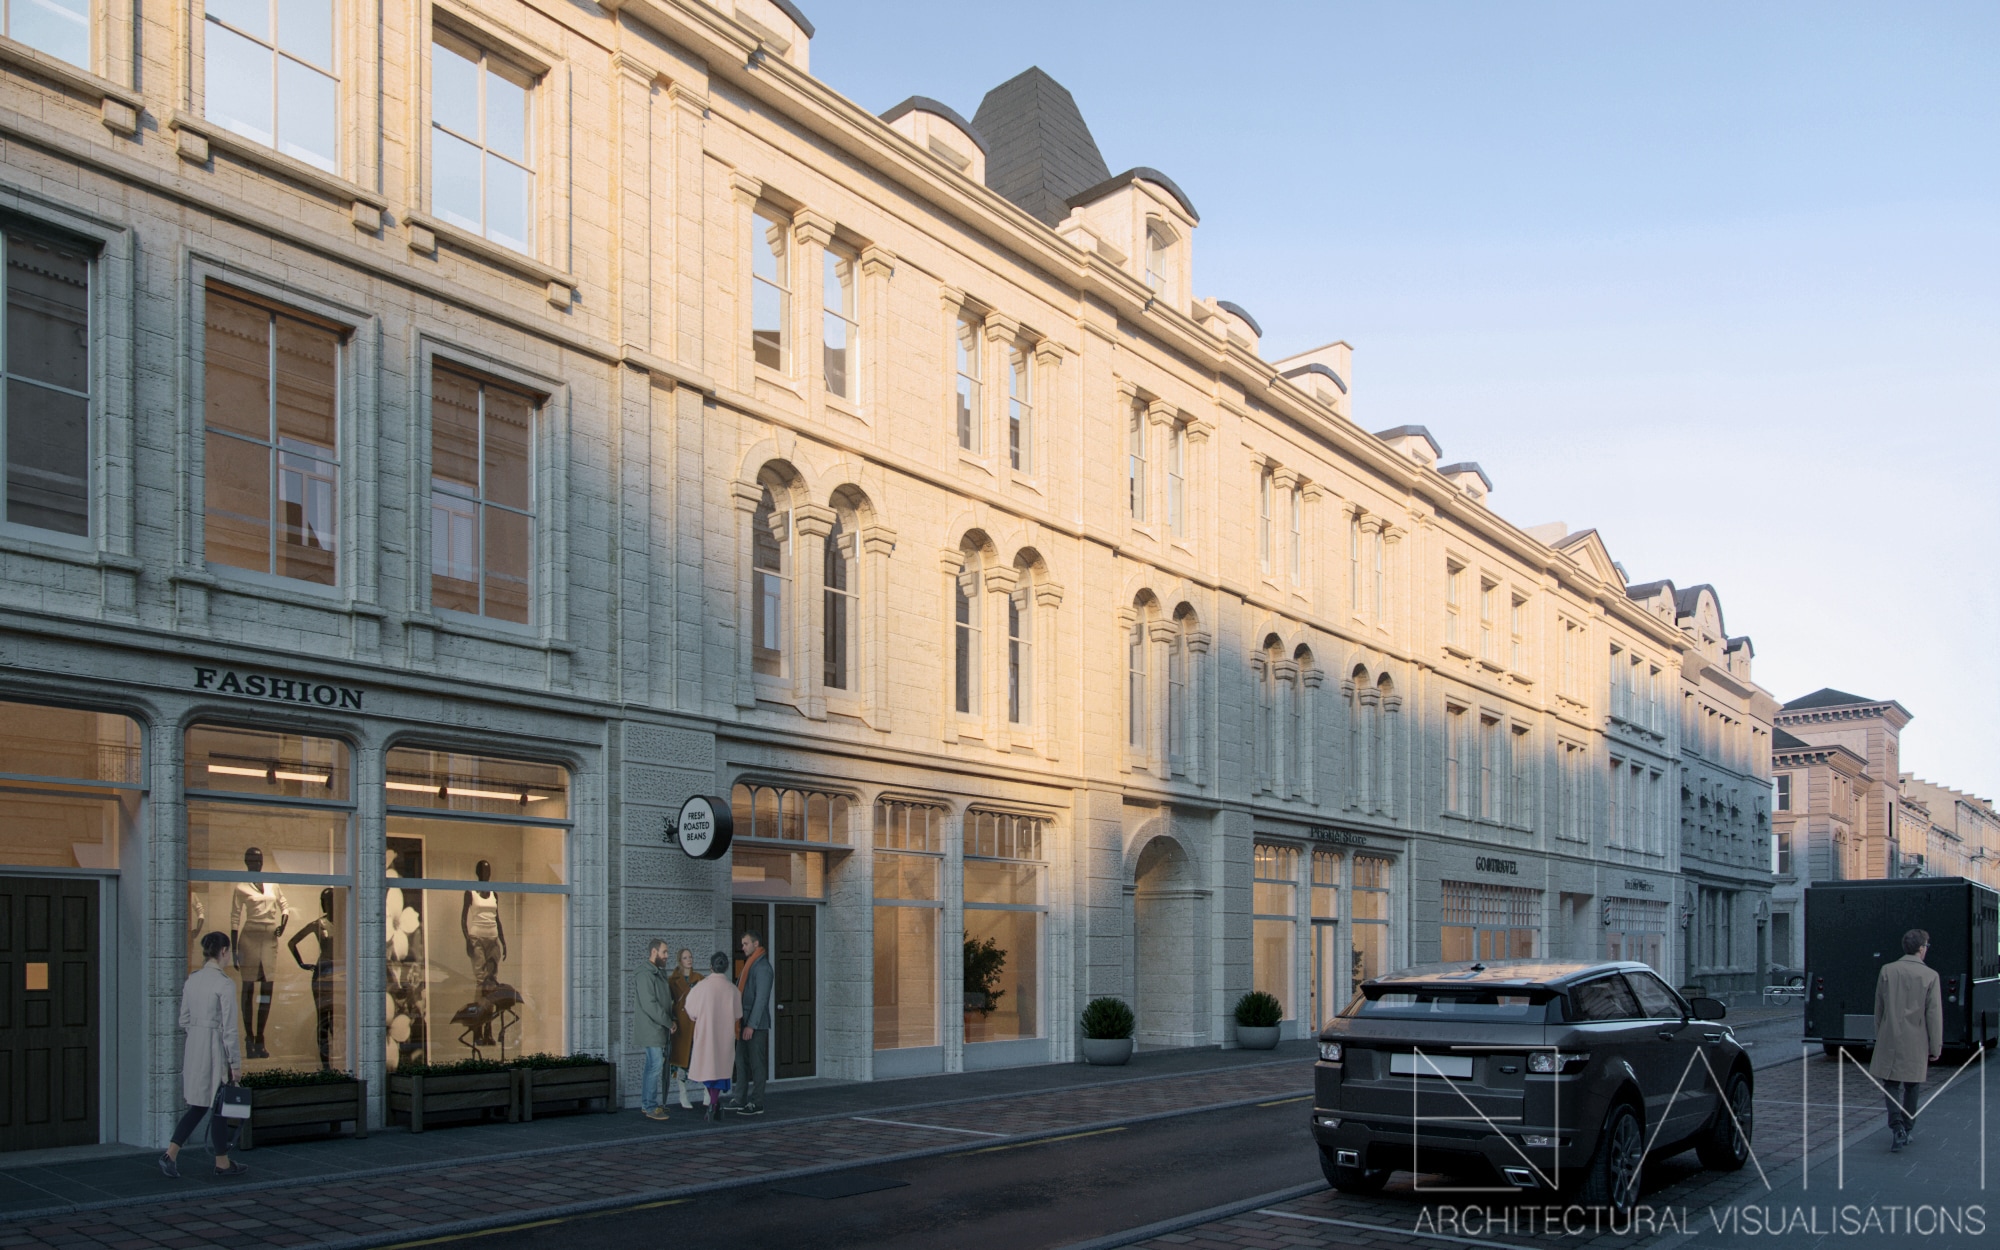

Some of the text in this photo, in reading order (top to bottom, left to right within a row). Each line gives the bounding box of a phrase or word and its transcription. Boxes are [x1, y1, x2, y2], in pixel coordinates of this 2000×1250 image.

[193, 666, 364, 710] FASHION
[688, 811, 706, 820] FRESH
[683, 821, 710, 831] ROASTED
[686, 832, 707, 841] BEANS
[1342, 831, 1367, 845] Store
